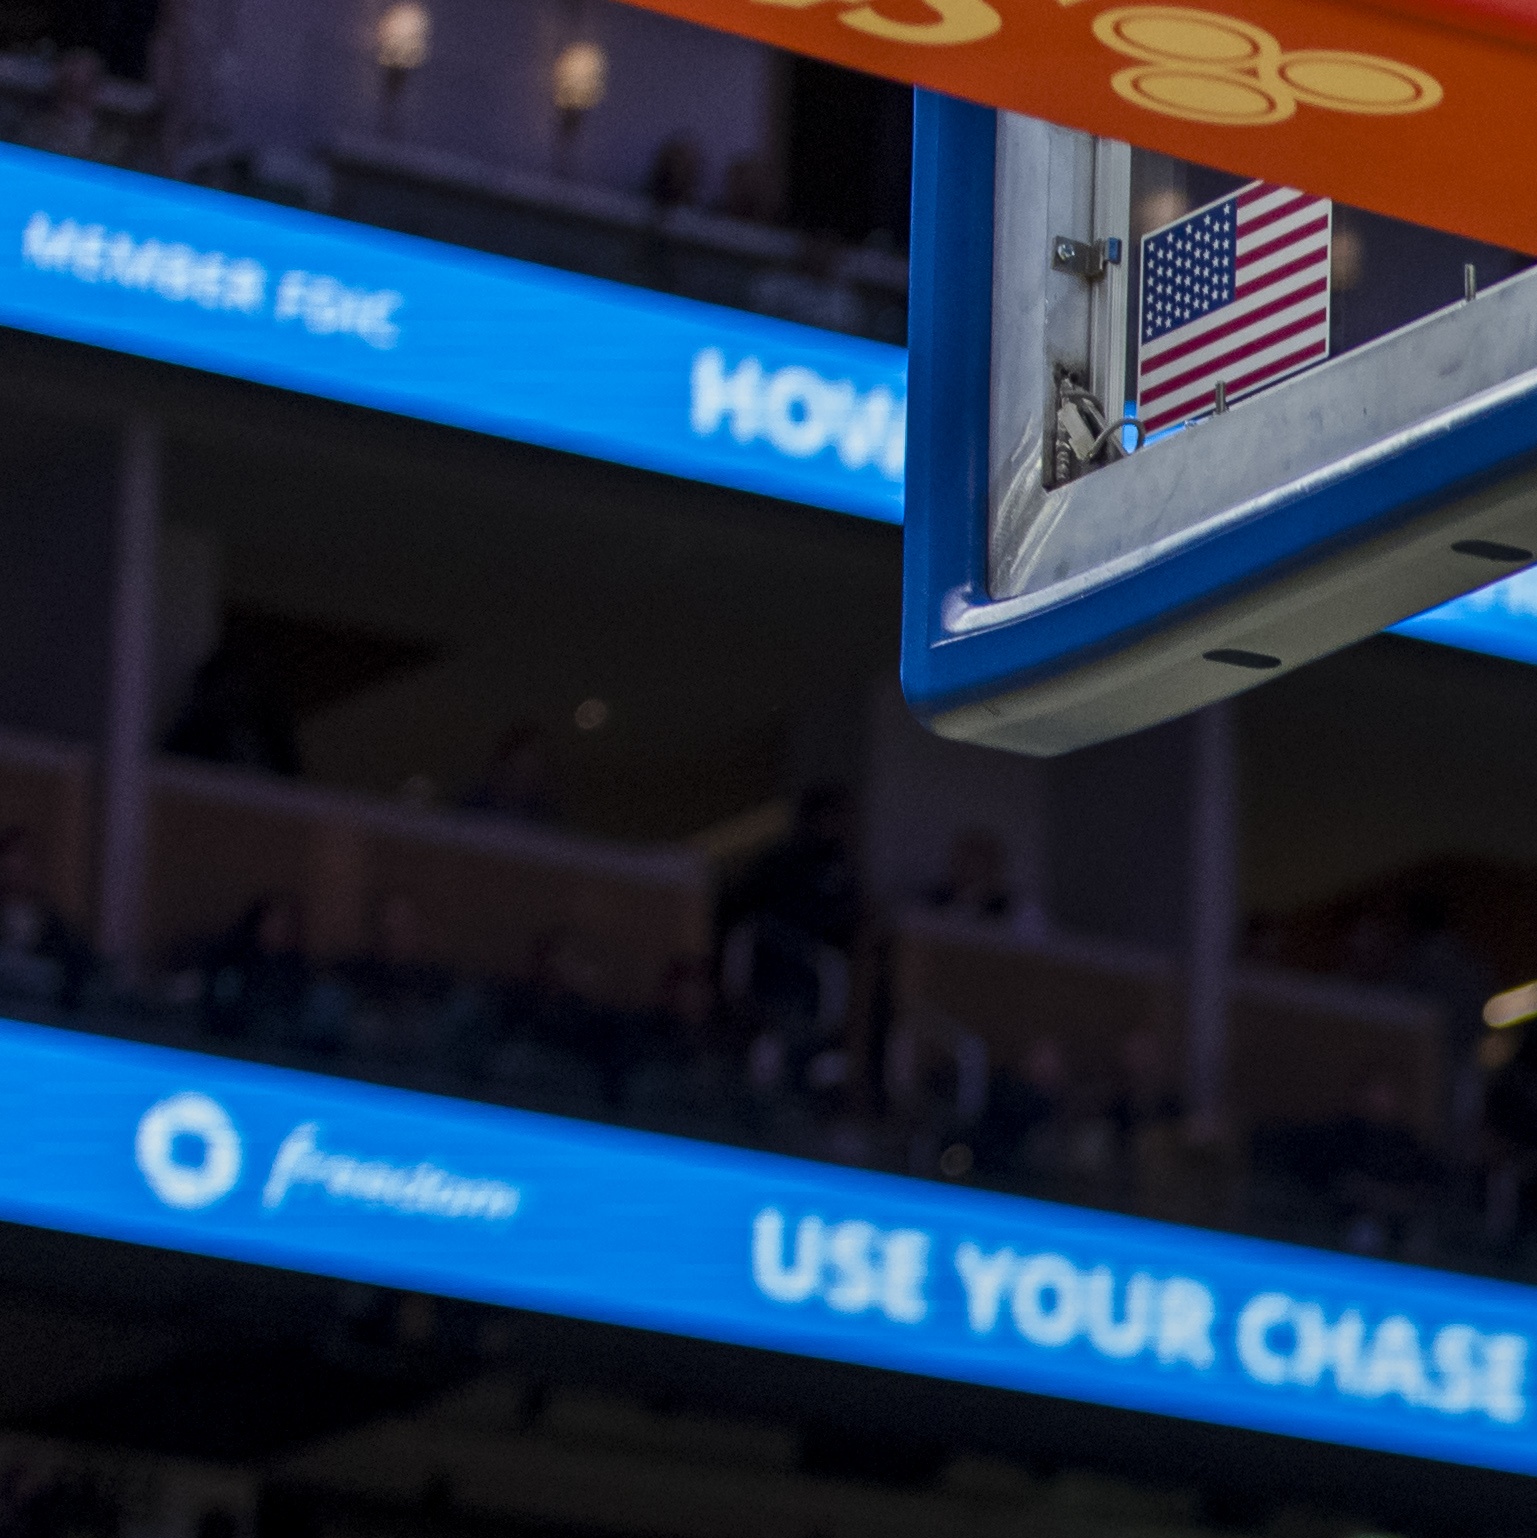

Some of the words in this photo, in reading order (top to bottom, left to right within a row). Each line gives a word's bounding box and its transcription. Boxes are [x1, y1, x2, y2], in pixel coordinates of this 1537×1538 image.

[23, 213, 265, 310] MEMBER
[753, 1208, 928, 1322] USE
[956, 1243, 1215, 1367] YOUR
[1237, 1293, 1526, 1422] CHASE
